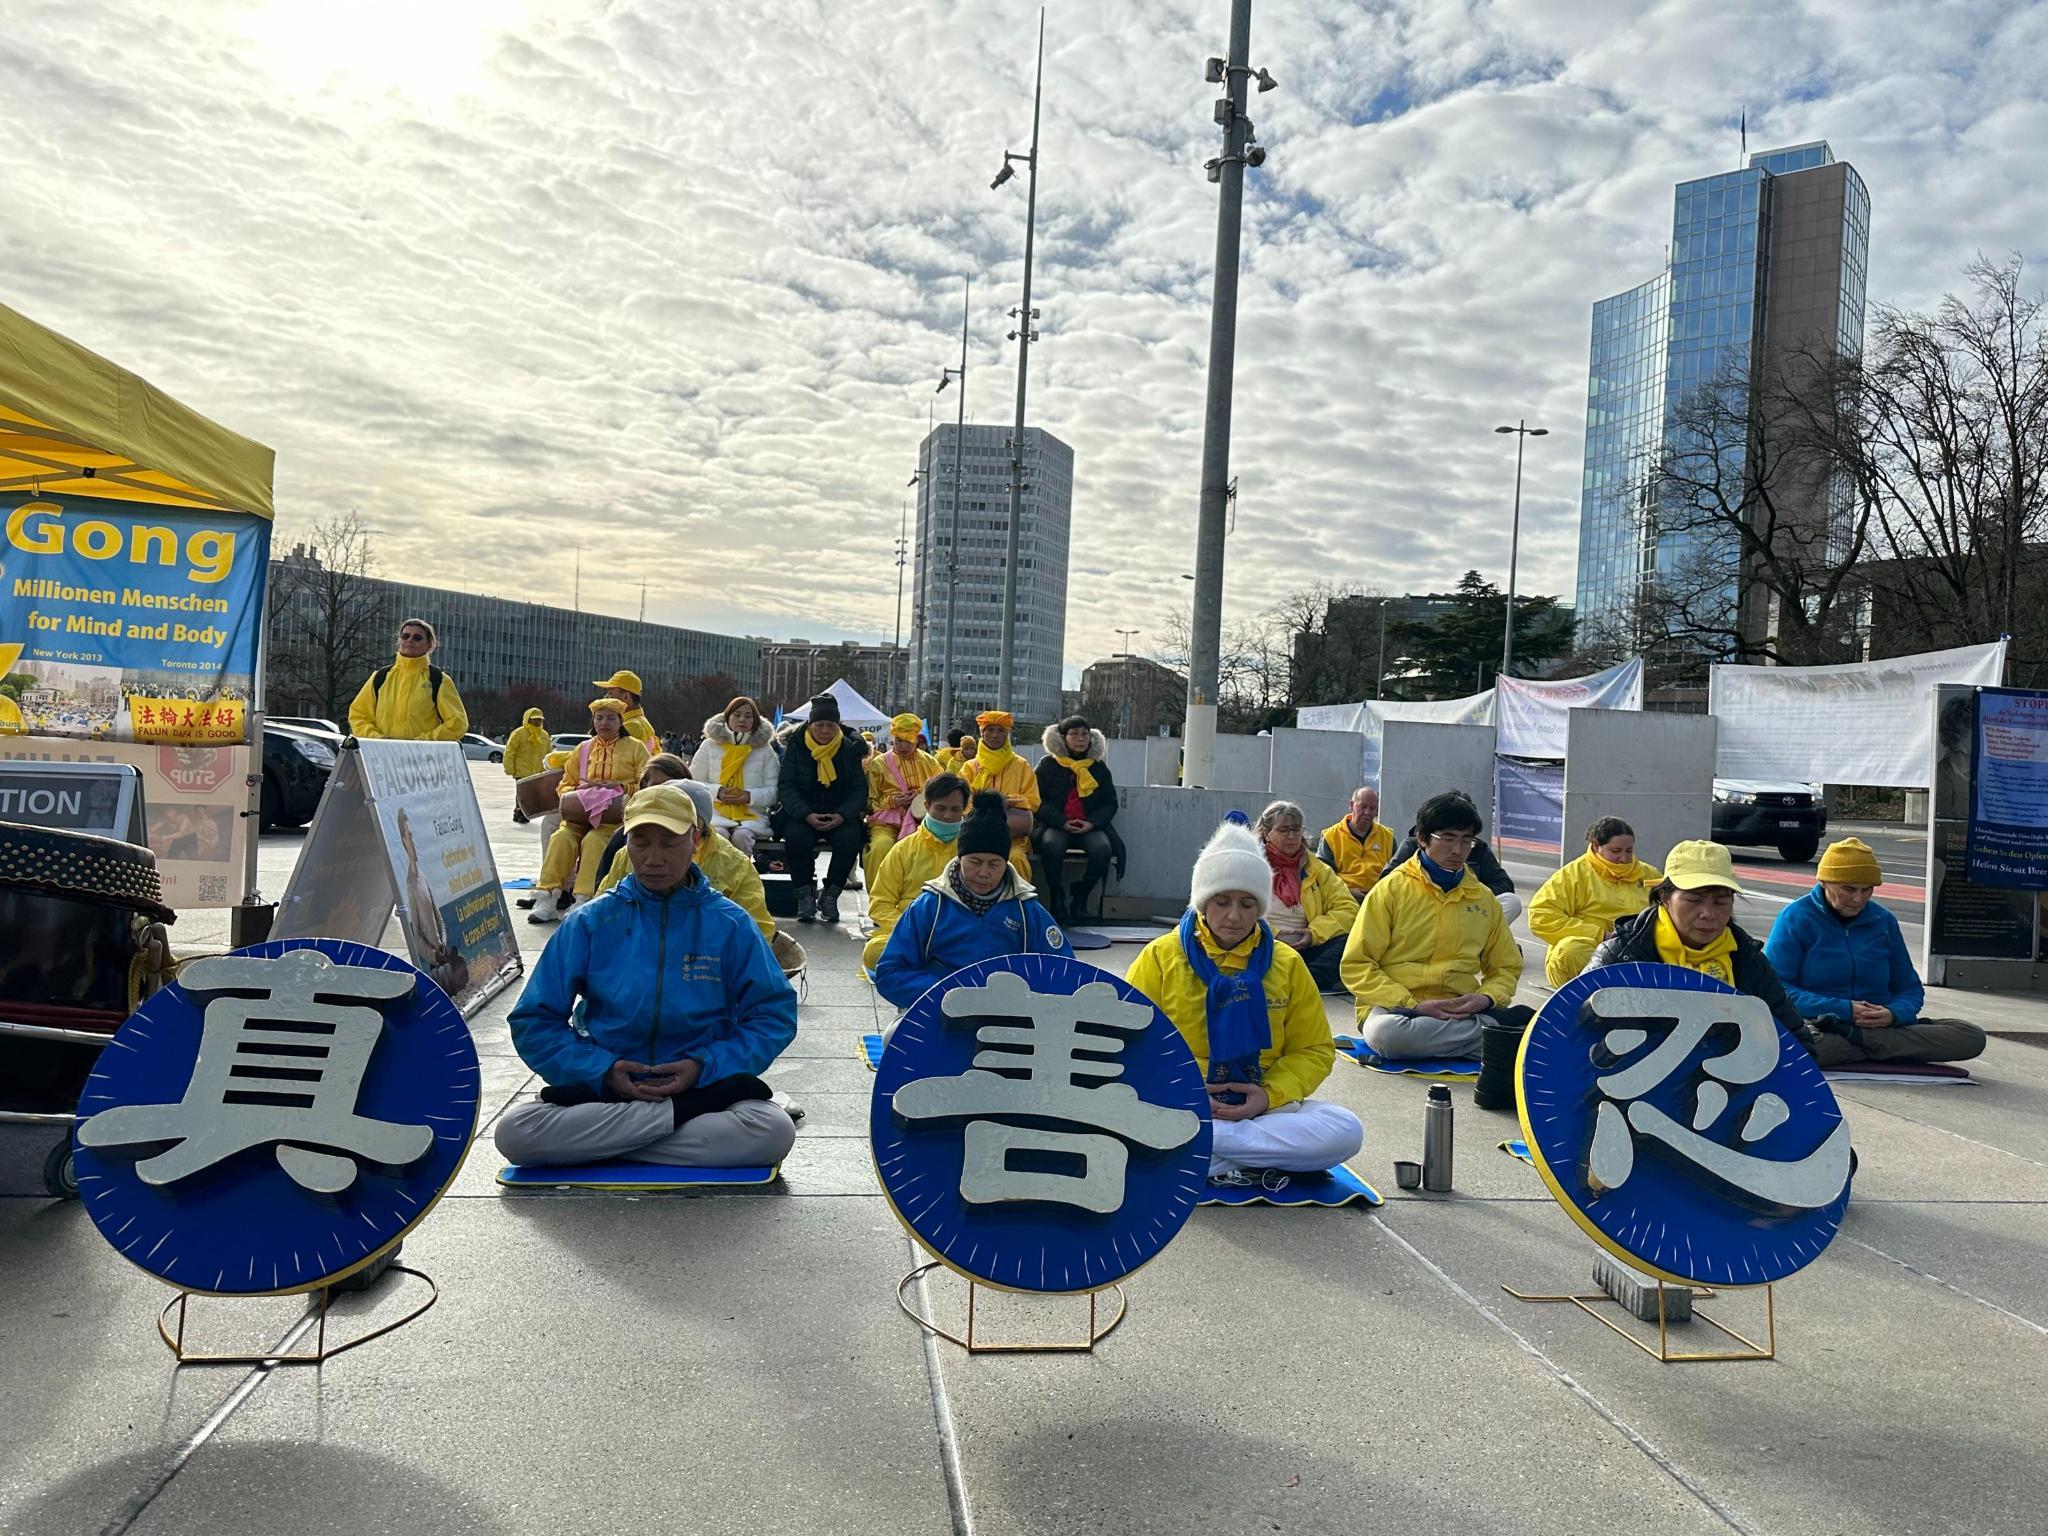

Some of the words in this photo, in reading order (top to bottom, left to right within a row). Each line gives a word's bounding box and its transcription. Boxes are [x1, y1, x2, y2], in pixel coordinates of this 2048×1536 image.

[5, 501, 237, 584] Gong
[13, 578, 116, 606] Millionen
[121, 588, 229, 614] Menschen
[28, 611, 62, 632] for
[66, 615, 122, 637] Mind
[126, 622, 168, 641] and
[173, 624, 228, 650] Body
[33, 648, 53, 659] New
[56, 650, 79, 661] York
[81, 652, 104, 663] 2013
[161, 659, 198, 670] Toronto
[199, 661, 223, 671] 2014
[138, 705, 236, 729] 法輪大法好
[138, 726, 169, 737] FALUN
[173, 728, 192, 738] DAFA
[195, 728, 204, 738] IS
[207, 728, 236, 738] GOOD
[76, 948, 434, 1193] 真
[892, 970, 1201, 1214] 善
[1590, 986, 1851, 1208] 忍
